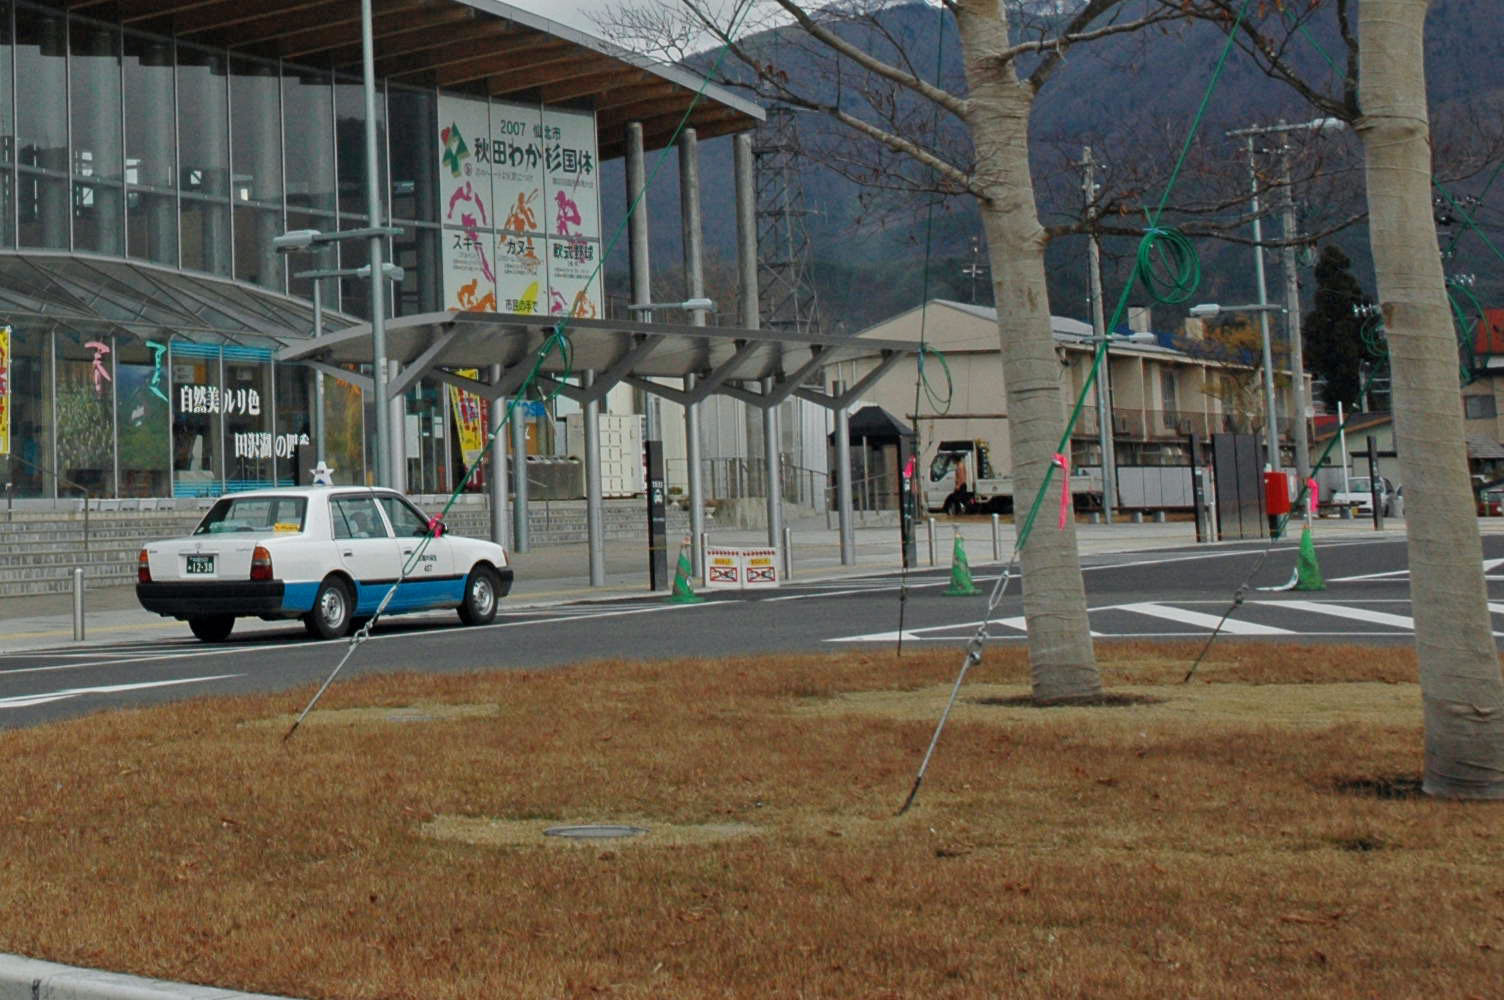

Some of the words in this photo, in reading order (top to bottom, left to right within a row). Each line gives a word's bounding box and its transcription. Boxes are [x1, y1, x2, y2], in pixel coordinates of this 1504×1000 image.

[500, 119, 526, 137] 2007
[474, 137, 594, 176] 秋田わか杉国体
[453, 235, 483, 249] スキー
[507, 240, 535, 256] カヌー
[181, 385, 260, 415] 自然美ルリ色
